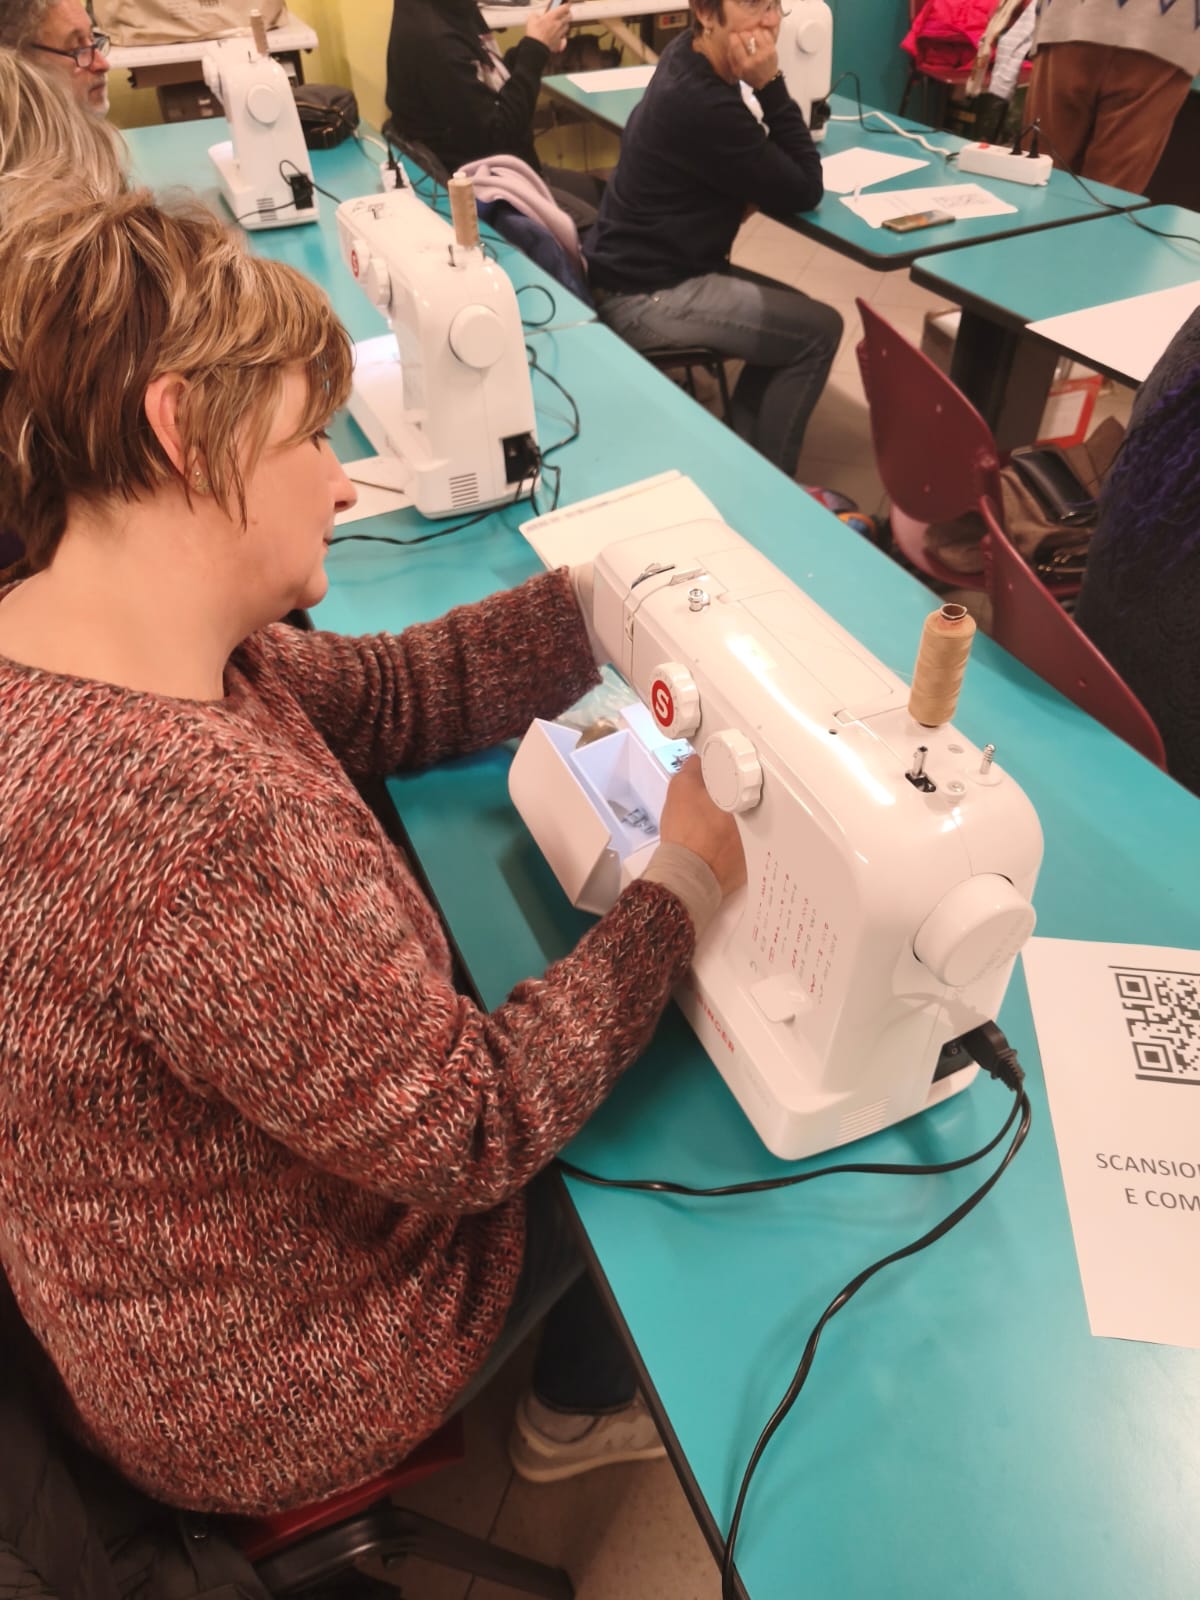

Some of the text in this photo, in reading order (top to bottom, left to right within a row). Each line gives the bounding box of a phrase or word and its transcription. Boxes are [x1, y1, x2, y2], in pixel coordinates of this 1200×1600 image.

[655, 687, 670, 720] S
[1095, 1152, 1200, 1179] SCANSIO
[1124, 1187, 1200, 1212] E COM
